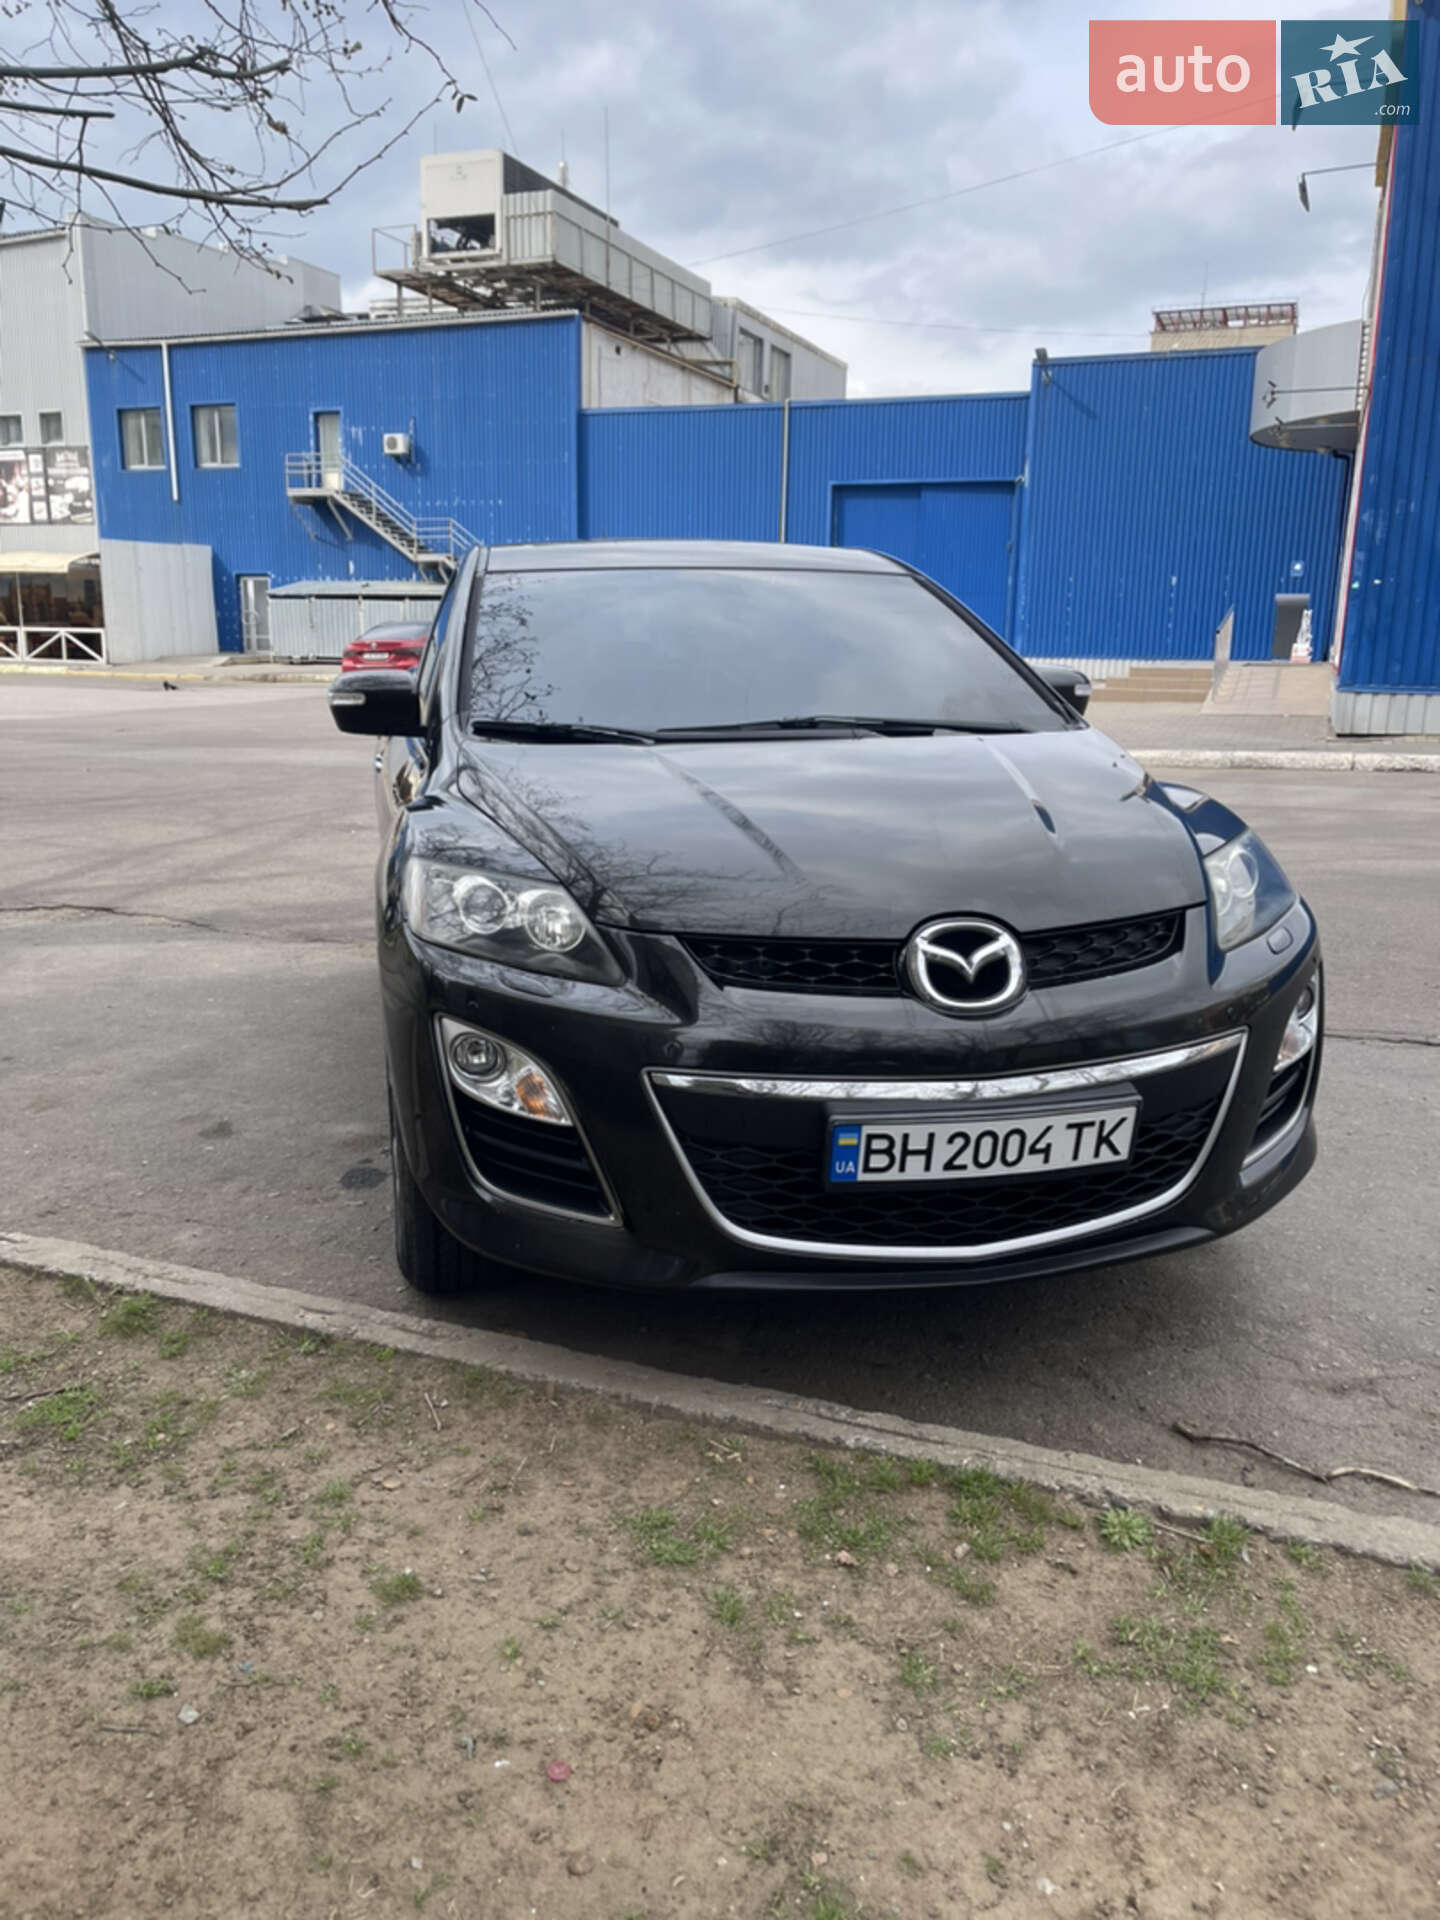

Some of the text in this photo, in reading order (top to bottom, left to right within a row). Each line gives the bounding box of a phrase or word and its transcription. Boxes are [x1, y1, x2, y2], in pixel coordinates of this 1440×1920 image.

[862, 1117, 1127, 1174] BH 2004 TK
[835, 1161, 855, 1174] UA
